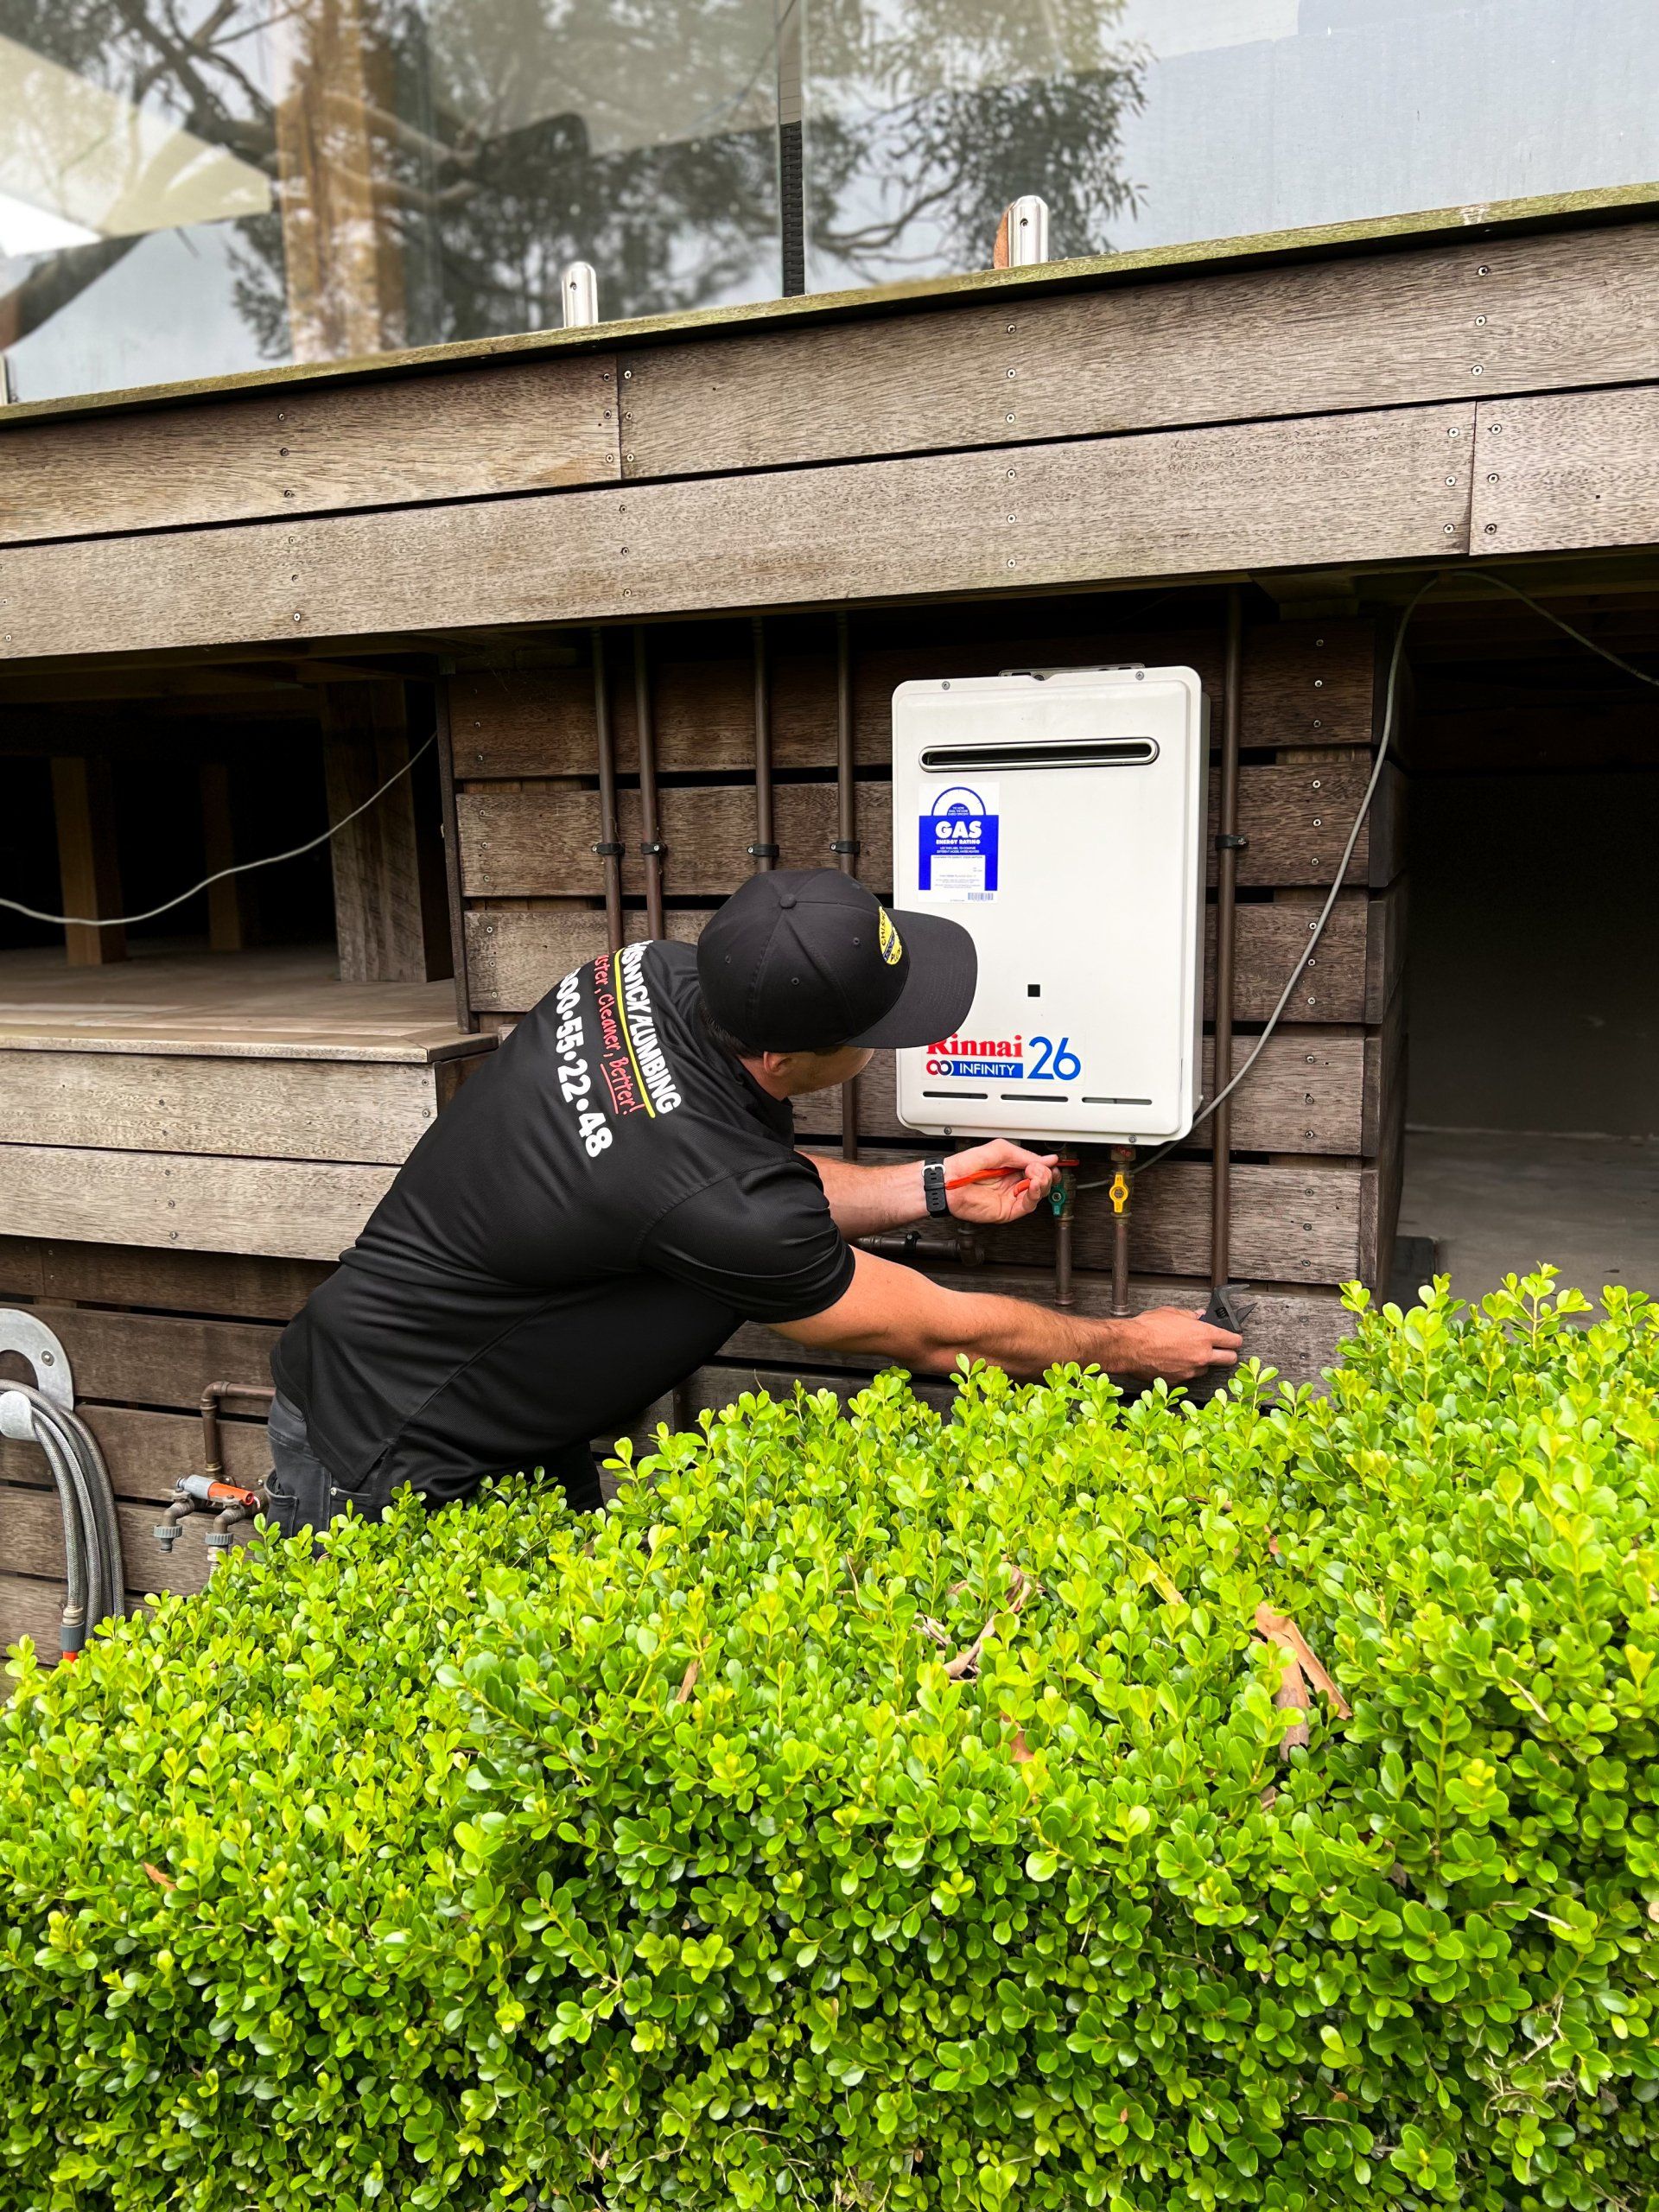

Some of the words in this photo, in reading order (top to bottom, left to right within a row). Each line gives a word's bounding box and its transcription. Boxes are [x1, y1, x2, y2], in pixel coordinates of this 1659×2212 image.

[935, 820, 982, 839] GAS
[620, 939, 654, 1013] HISWICK
[628, 1014, 682, 1114] PLUMBING
[959, 1063, 1016, 1077] INFINITY
[1027, 1035, 1082, 1081] 26
[609, 1057, 645, 1116] Better!
